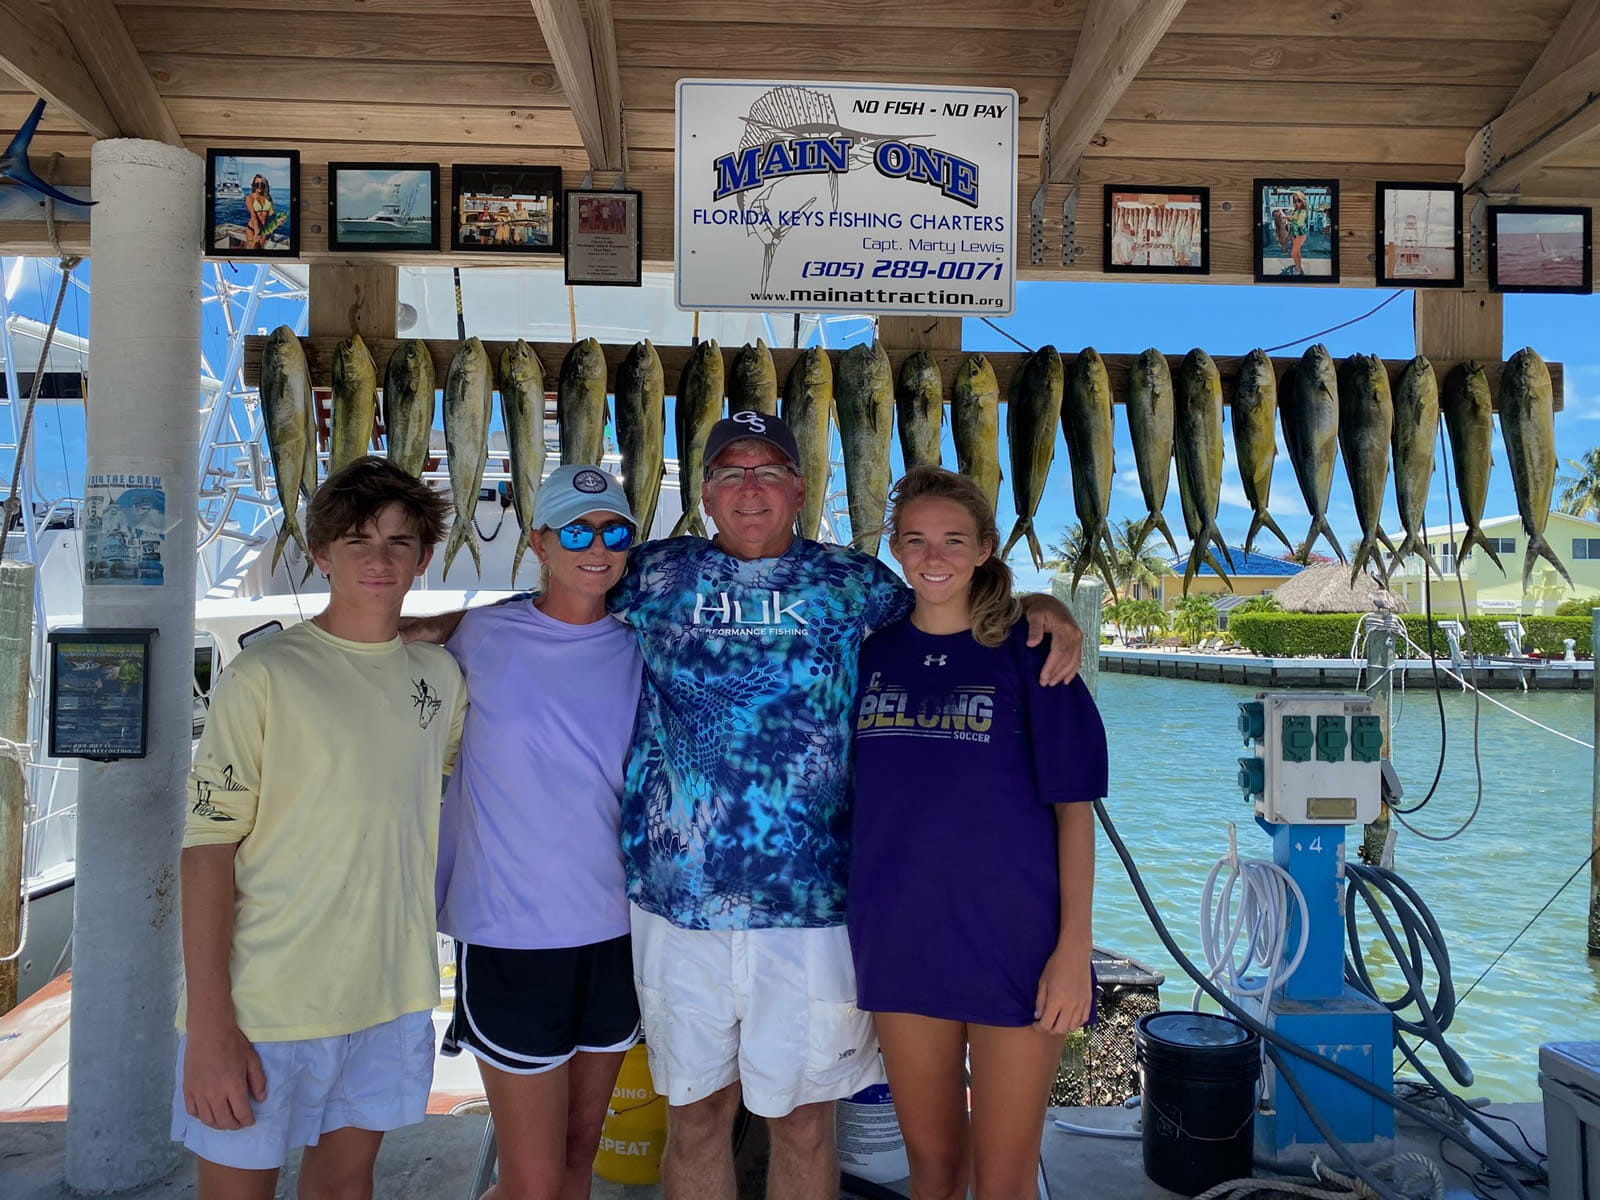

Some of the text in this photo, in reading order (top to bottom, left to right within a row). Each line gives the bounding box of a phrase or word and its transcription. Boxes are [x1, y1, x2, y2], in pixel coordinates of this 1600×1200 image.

[852, 100, 880, 114] NO
[883, 101, 926, 115] FISH
[942, 103, 969, 117] NO
[973, 104, 1008, 118] PAY
[713, 137, 980, 209] MAIN ONE
[693, 209, 1005, 232] FLORIDA KEYS FISHING CHARTERS
[862, 237, 1005, 255] Capt. Marty Lewis
[801, 259, 1004, 281] (305) 289-0071
[750, 288, 1004, 308] www.mainattraction.org
[106, 474, 125, 484] THE
[128, 475, 161, 486] CREW
[693, 591, 809, 625] HUK
[769, 627, 809, 636] FISHING
[857, 692, 994, 732] BELONG
[953, 730, 991, 743] SOCCER
[1309, 836, 1323, 853] 4
